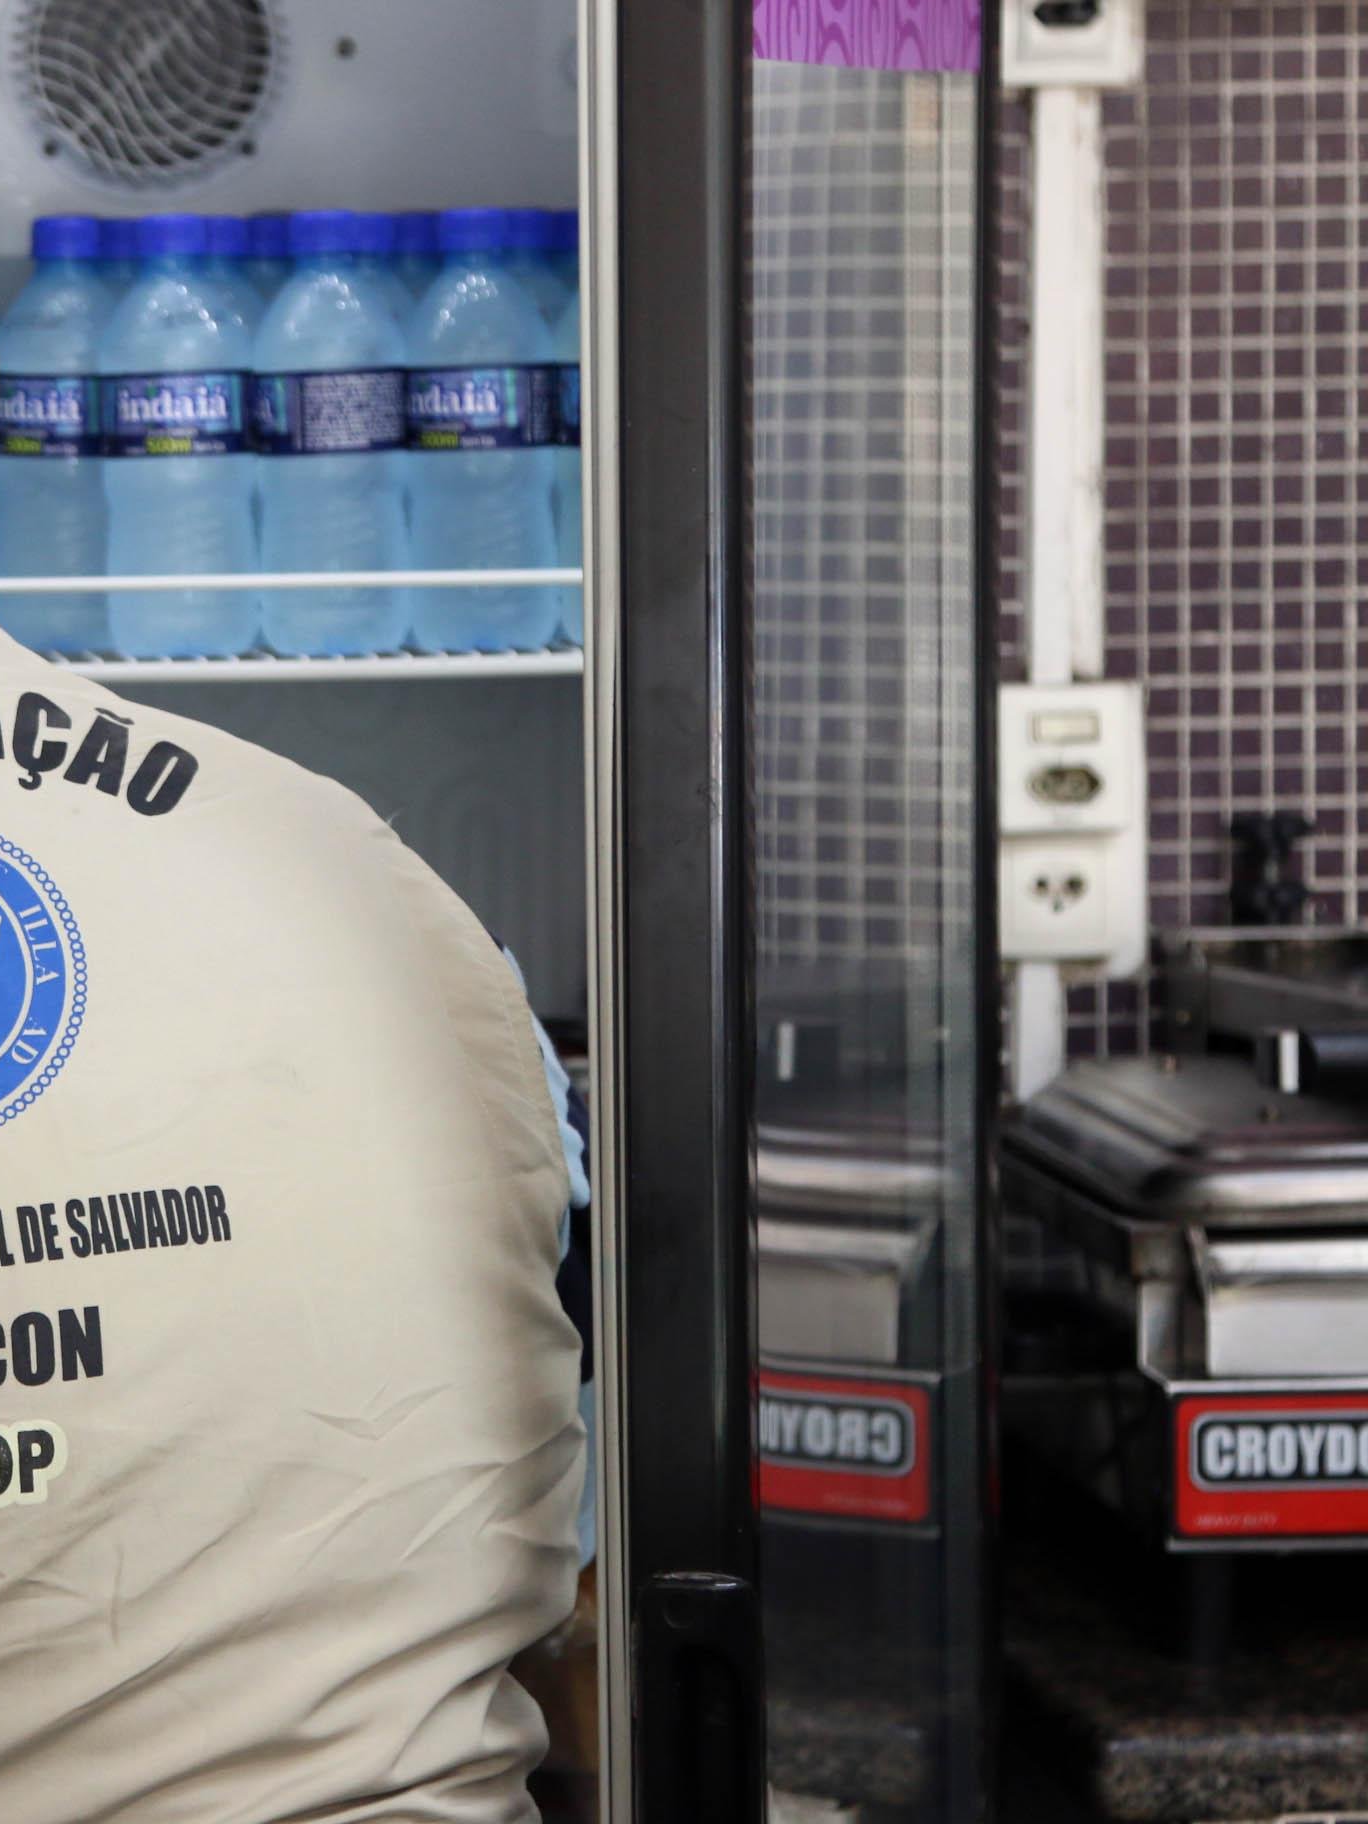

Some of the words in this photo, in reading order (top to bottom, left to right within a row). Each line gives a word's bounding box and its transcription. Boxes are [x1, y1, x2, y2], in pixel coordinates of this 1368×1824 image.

[18, 903, 60, 986] ILLA
[11, 1015, 48, 1065] AD
[16, 1204, 64, 1263] DE
[65, 1184, 232, 1258] SALVADOR
